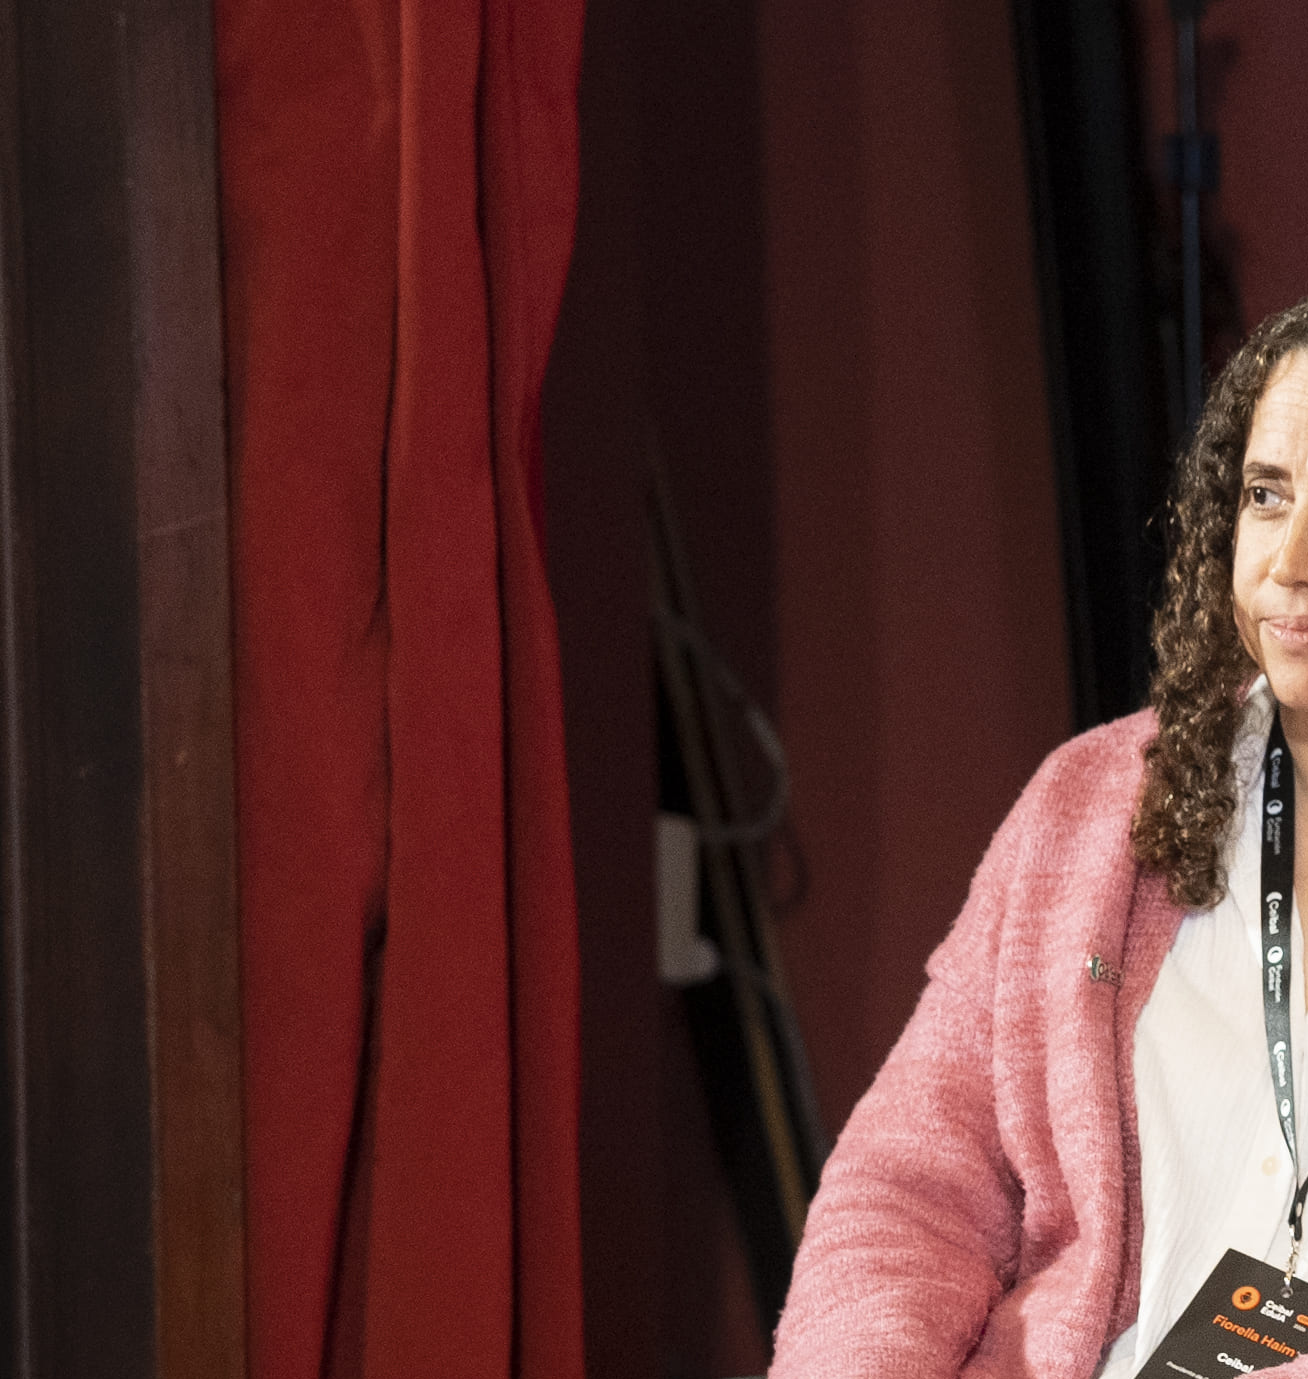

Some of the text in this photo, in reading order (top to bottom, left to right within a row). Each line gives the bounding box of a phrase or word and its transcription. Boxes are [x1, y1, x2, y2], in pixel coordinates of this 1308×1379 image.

[1268, 900, 1280, 935] Ceibal
[1265, 1299, 1295, 1318] Ceibal
[1212, 1313, 1261, 1343] Fiorella
[1259, 1334, 1297, 1358] Haim
[1216, 1352, 1255, 1375] Ceibal
